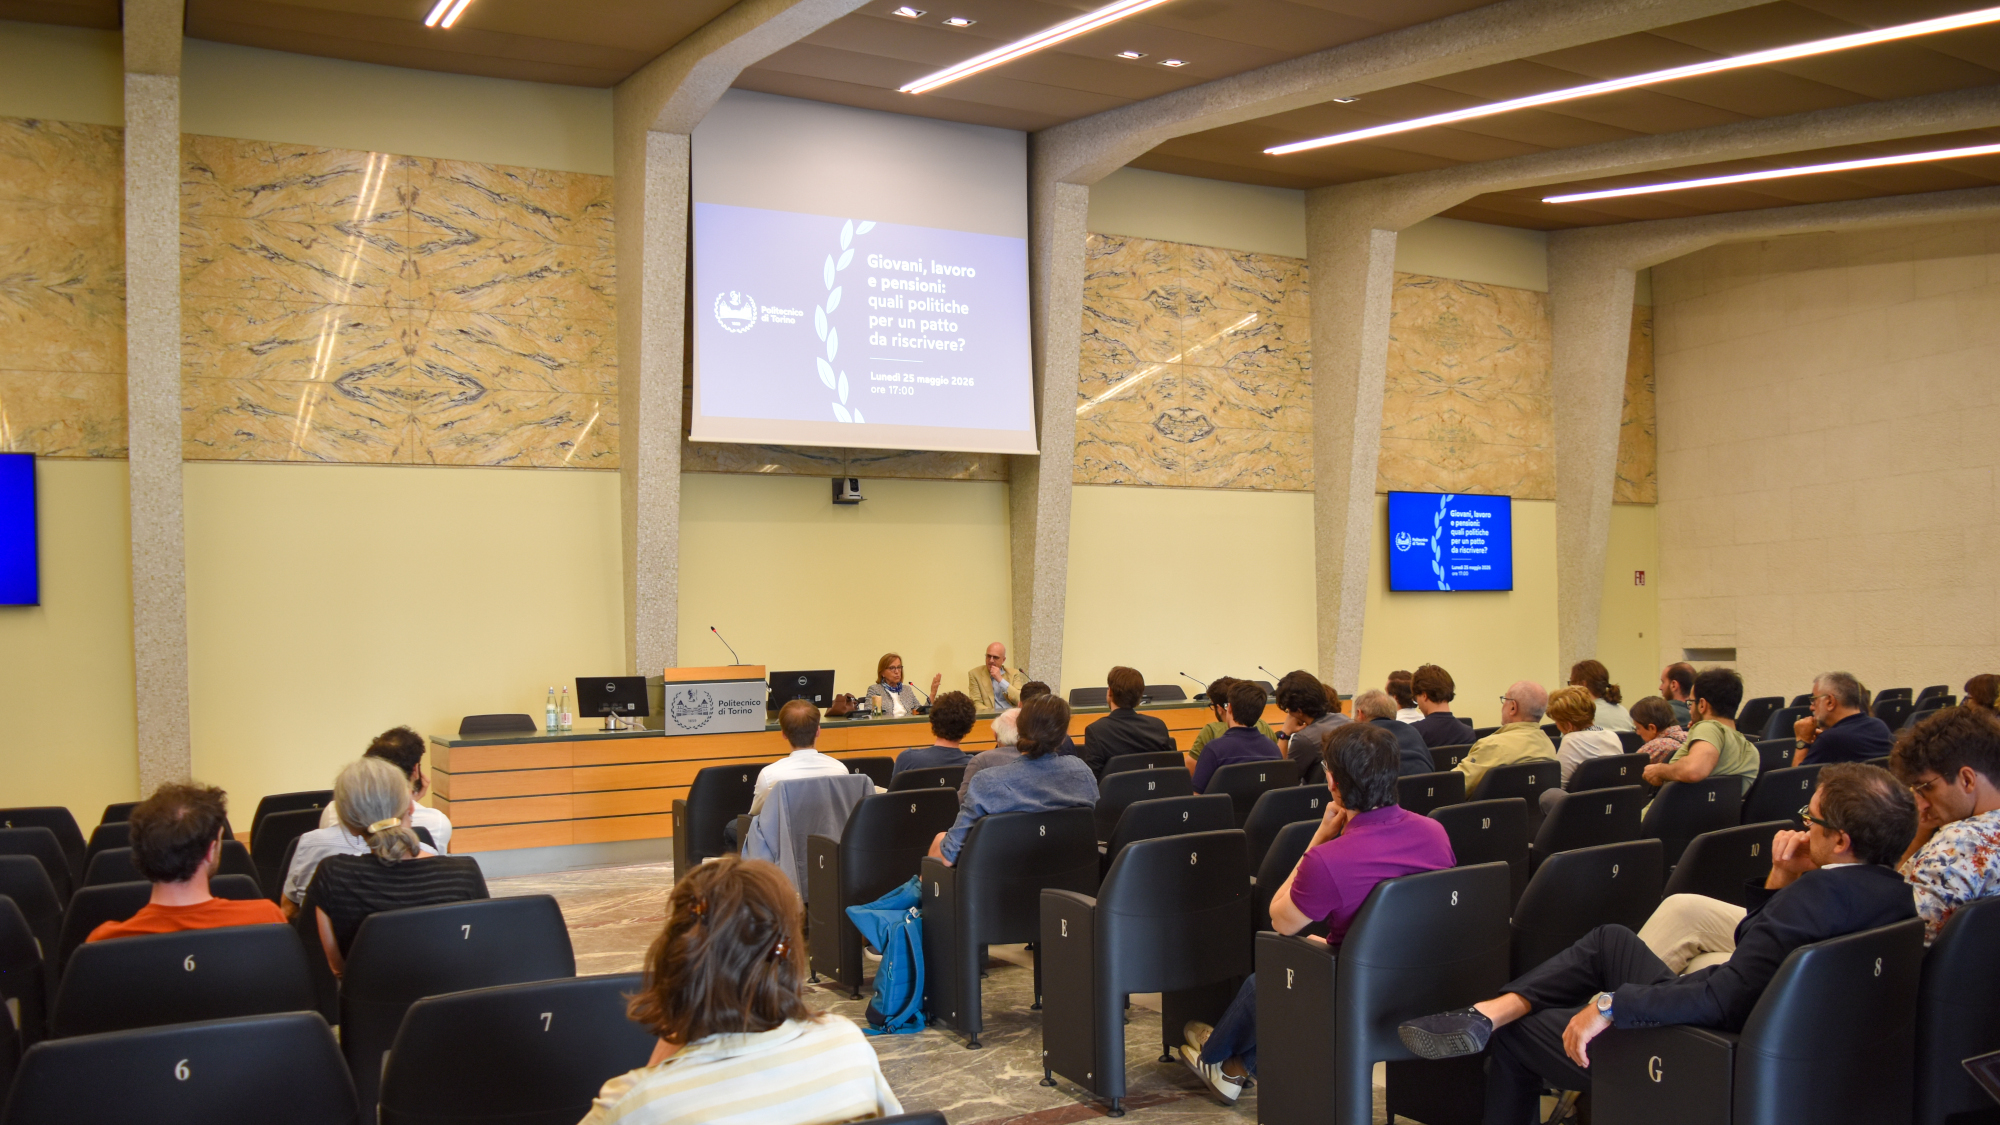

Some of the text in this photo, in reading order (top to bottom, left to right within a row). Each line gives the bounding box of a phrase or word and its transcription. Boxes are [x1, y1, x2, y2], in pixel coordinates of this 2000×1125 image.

[868, 254, 976, 278] Giovani, lavoro
[868, 277, 946, 294] e pensioni:
[761, 306, 804, 316] Politecnico
[868, 295, 969, 314] quali politiche
[761, 314, 796, 324] di Torino
[869, 315, 958, 333] per un patto
[869, 331, 966, 351] da riscrivere?
[870, 371, 974, 386] Lunedì 25 maggio 2026
[889, 386, 914, 395] 17:00
[1450, 510, 1473, 518] Giovani,
[1455, 519, 1480, 527] pensioni:
[1450, 528, 1489, 537] quali politiche
[719, 699, 761, 707] Politecnico
[742, 774, 748, 783] 8
[939, 777, 945, 787] 9
[1259, 773, 1266, 782] 11
[1528, 774, 1536, 785] 12
[1147, 781, 1156, 791] 10
[1427, 787, 1434, 797] 11
[1310, 797, 1319, 809] 10
[1708, 791, 1716, 802] 12
[910, 803, 917, 814] 8
[1605, 803, 1613, 815] 11
[1182, 811, 1189, 822] 9
[1481, 817, 1491, 830] 10
[1039, 824, 1046, 837] 8
[1750, 842, 1760, 857] 10
[1190, 851, 1198, 865] 8
[1612, 863, 1619, 878] 9
[934, 881, 940, 897] D
[1450, 890, 1459, 906] 8
[461, 924, 471, 940] 7
[1061, 918, 1068, 938] E
[183, 954, 196, 972] 6
[1873, 957, 1882, 977] 8
[1286, 967, 1295, 990] F
[540, 1011, 553, 1032] 7
[174, 1058, 190, 1081] 6
[1648, 1055, 1663, 1083] G
